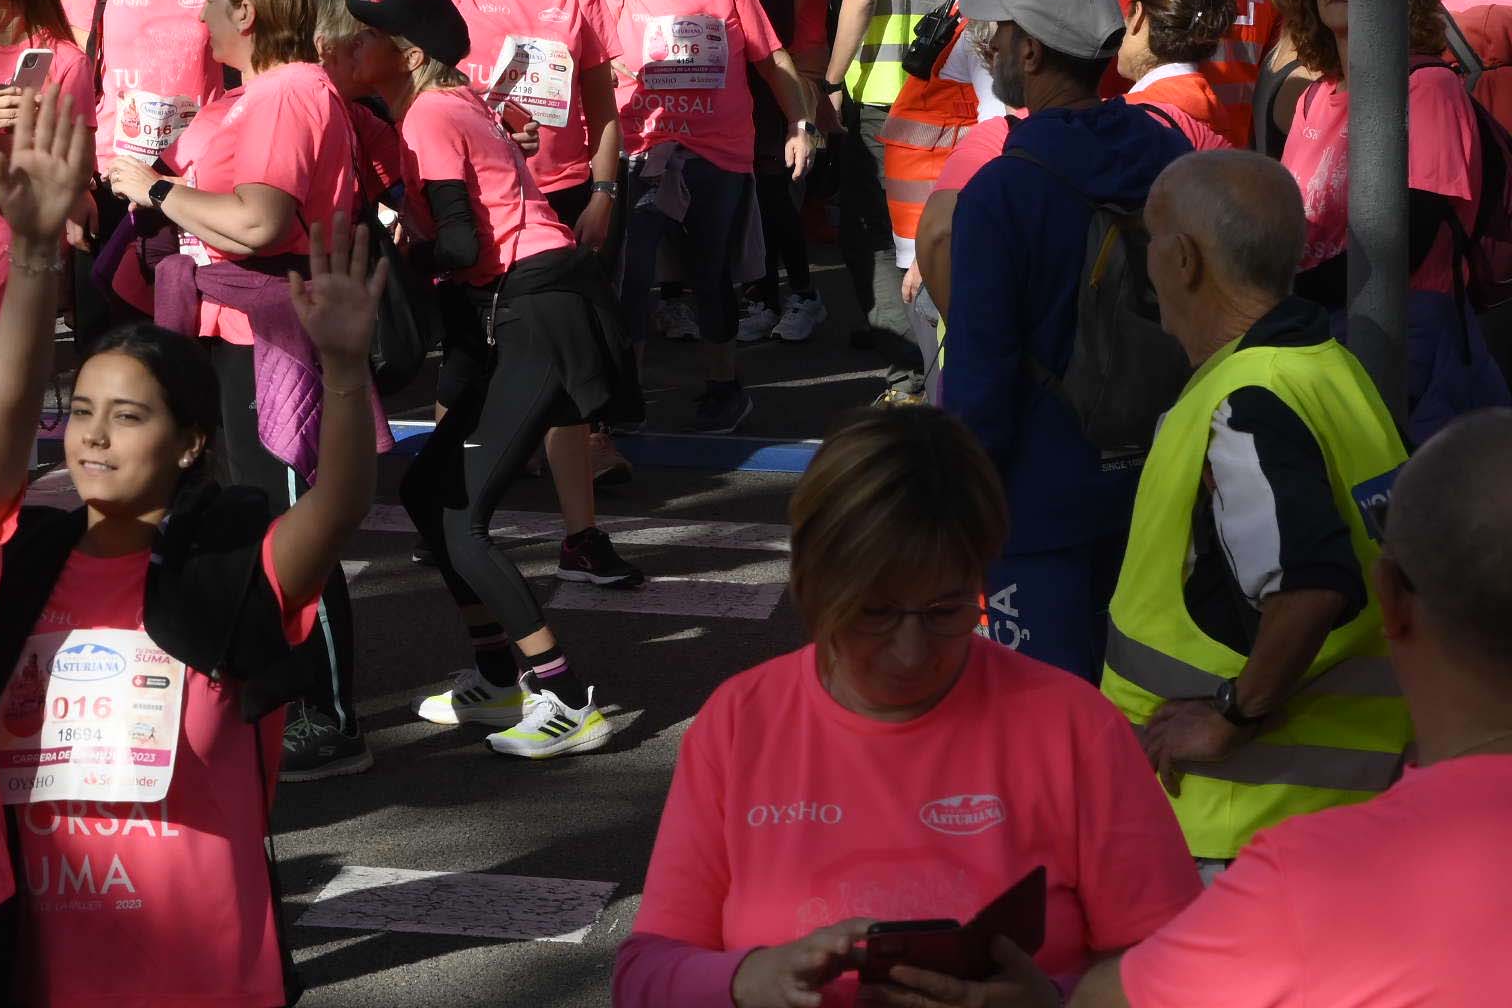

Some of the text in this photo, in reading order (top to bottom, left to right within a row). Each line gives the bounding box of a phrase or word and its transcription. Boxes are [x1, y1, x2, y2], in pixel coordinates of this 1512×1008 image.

[671, 43, 700, 55] 016
[112, 68, 139, 89] TU
[468, 63, 491, 85] TU
[631, 93, 715, 114] DORSAL
[143, 123, 172, 139] 016
[631, 117, 693, 135] SMA
[53, 658, 120, 673] ASTURIANA
[134, 653, 172, 665] SUMA
[53, 696, 113, 720] 016
[58, 750, 71, 760] DE
[8, 774, 55, 791] OYSHO
[747, 801, 843, 828] OYSHO
[926, 800, 1006, 828] ASTURIANA
[115, 899, 143, 910] 2023
